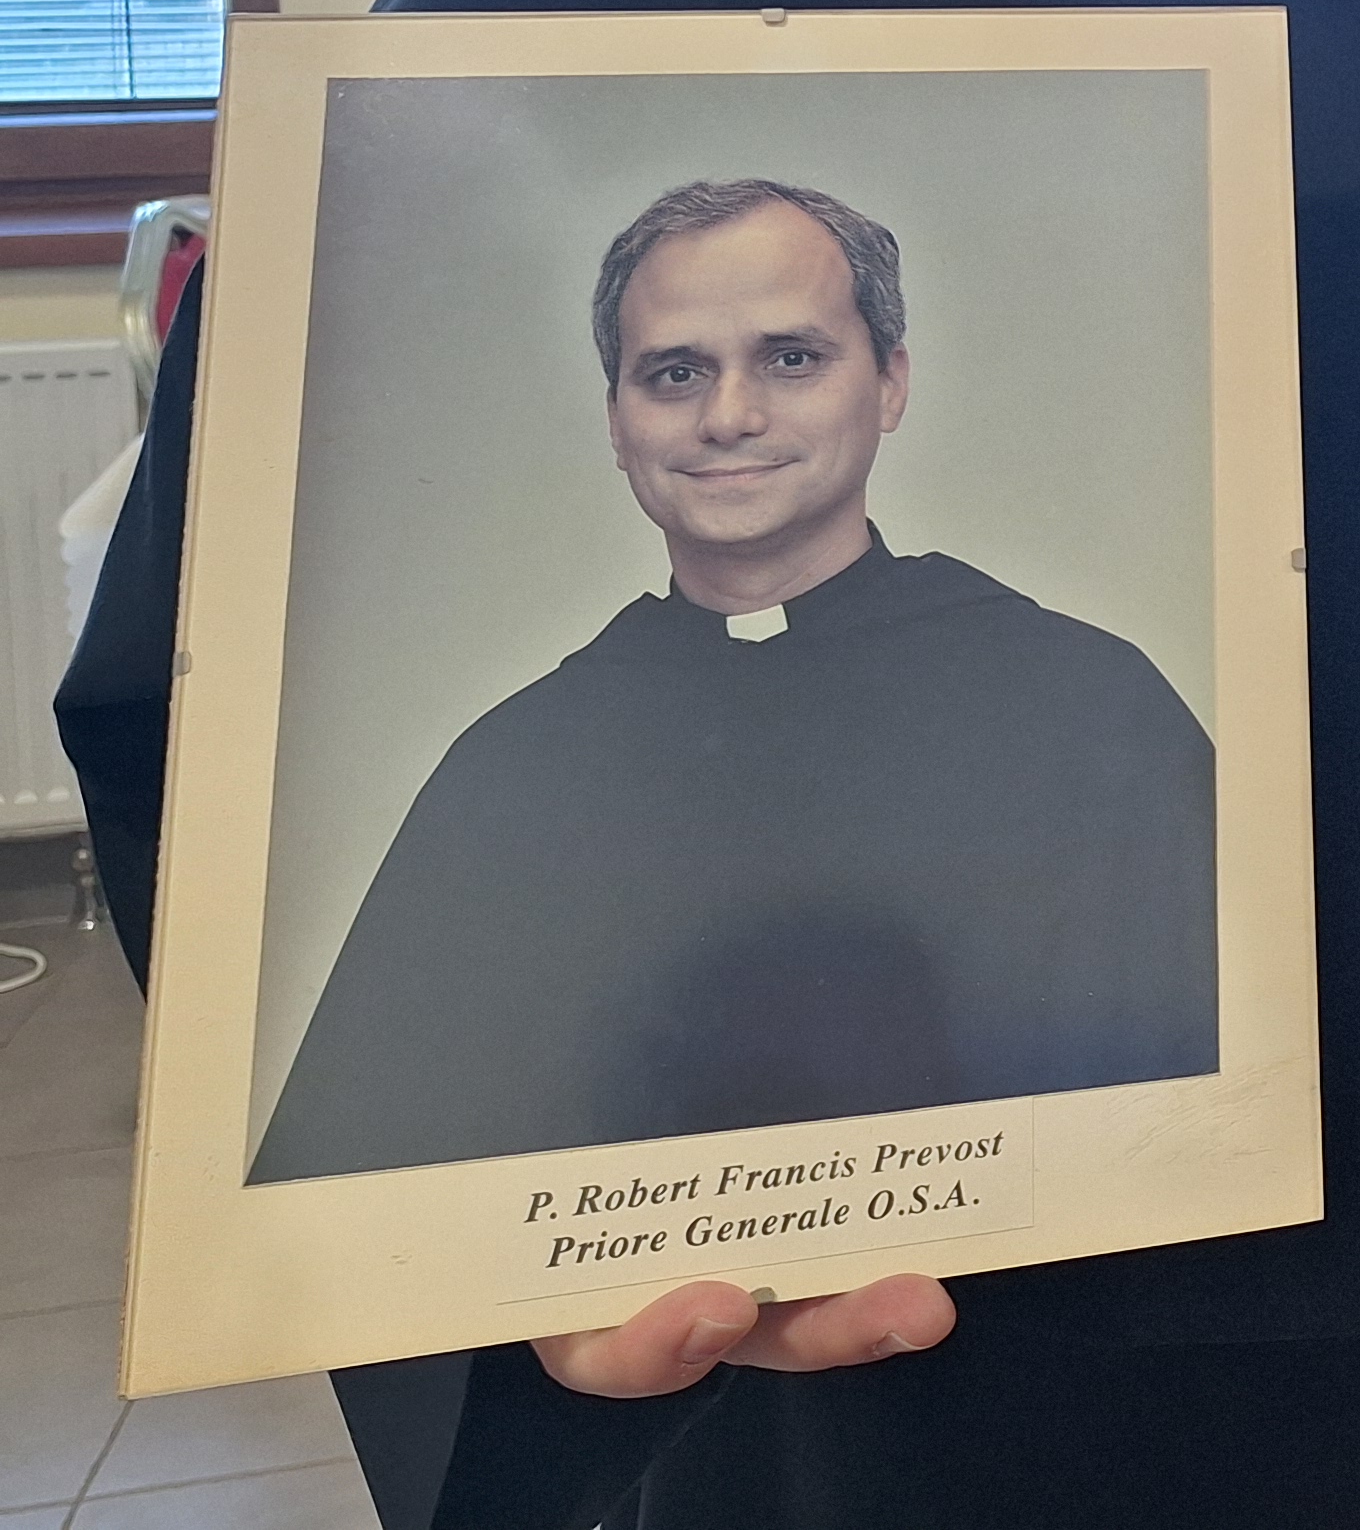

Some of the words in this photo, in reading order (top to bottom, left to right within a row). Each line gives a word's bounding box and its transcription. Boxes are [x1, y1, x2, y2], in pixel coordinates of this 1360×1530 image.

[523, 1191, 558, 1223] P.
[571, 1173, 702, 1217] Robert
[713, 1150, 857, 1196] Francis
[870, 1130, 1005, 1174] Prevost
[545, 1230, 668, 1269] Priore
[685, 1197, 851, 1247] Generale
[866, 1179, 981, 1220] O.S.A.
